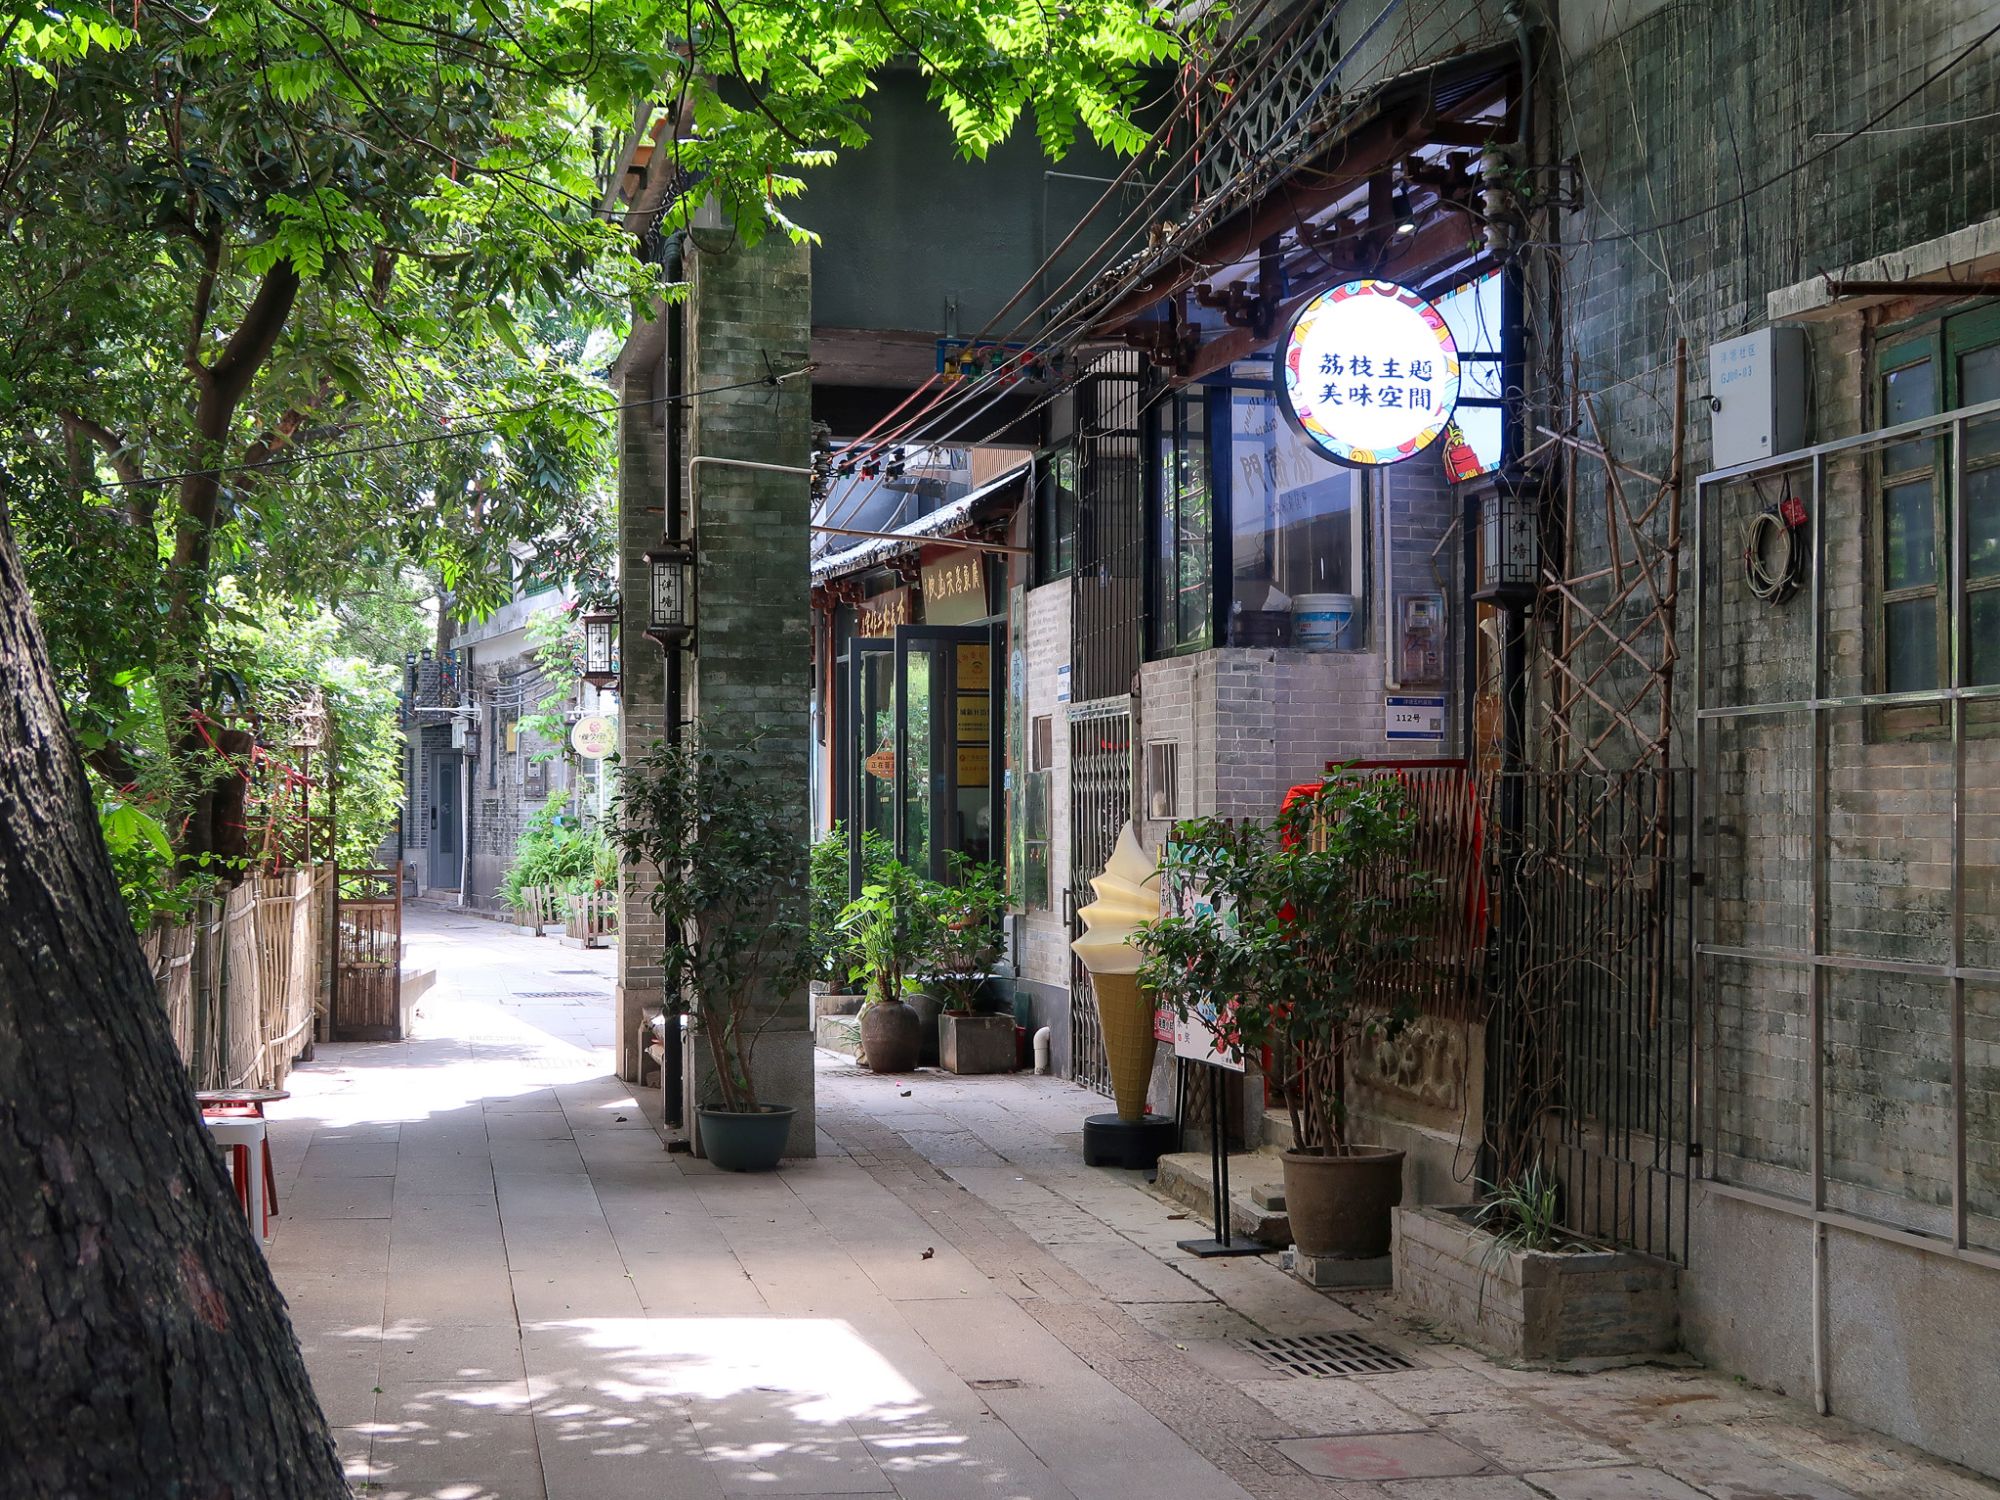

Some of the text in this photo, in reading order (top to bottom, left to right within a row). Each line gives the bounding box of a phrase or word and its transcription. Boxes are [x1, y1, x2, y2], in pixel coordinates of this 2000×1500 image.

[1318, 352, 1433, 382] 荔枝主題
[1317, 382, 1432, 411] 美味空間
[1396, 713, 1421, 723] 112号
